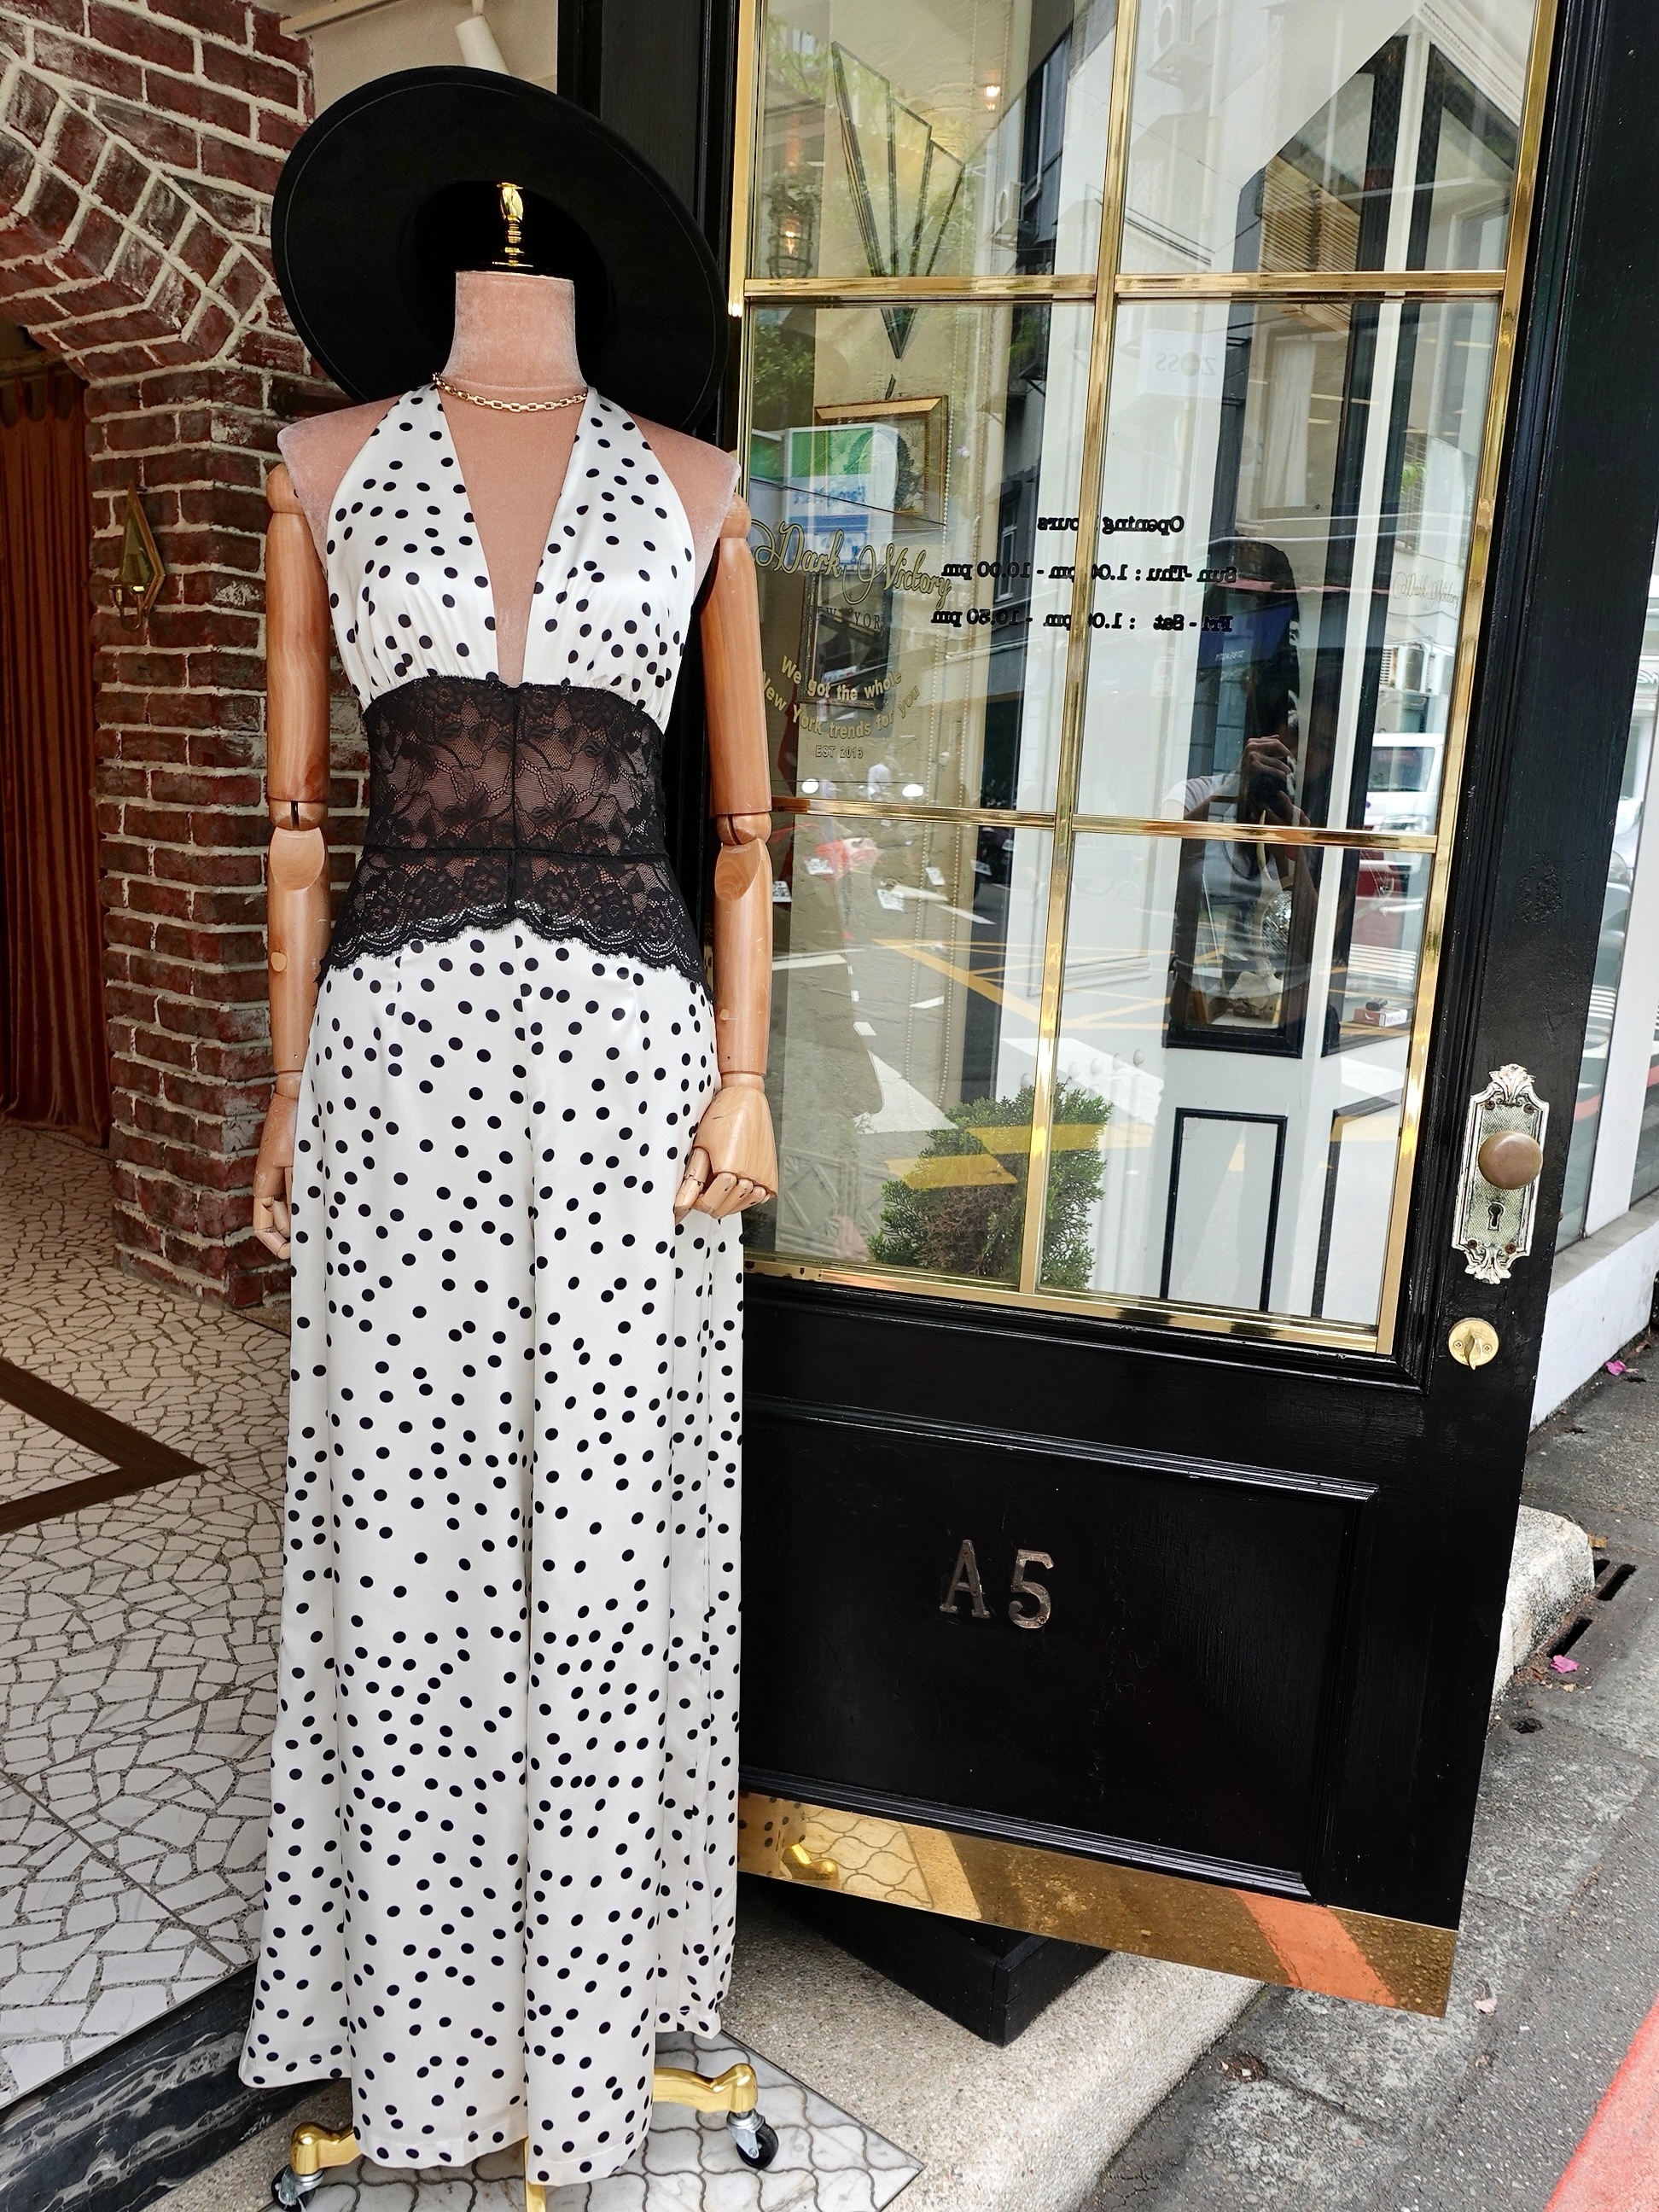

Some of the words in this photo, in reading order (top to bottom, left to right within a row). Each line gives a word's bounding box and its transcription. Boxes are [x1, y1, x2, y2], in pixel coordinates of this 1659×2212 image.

[752, 518, 844, 579] Dark
[842, 542, 952, 611] Victory
[853, 610, 883, 631] YOR
[781, 655, 802, 684] We
[806, 678, 830, 698] got
[836, 684, 859, 701] the
[864, 670, 902, 699] whole
[762, 670, 788, 712] New
[793, 704, 823, 736] York
[829, 720, 871, 740] trends
[876, 711, 894, 727] for
[898, 685, 921, 719] you
[815, 744, 835, 759] EST
[839, 746, 864, 760] 2013
